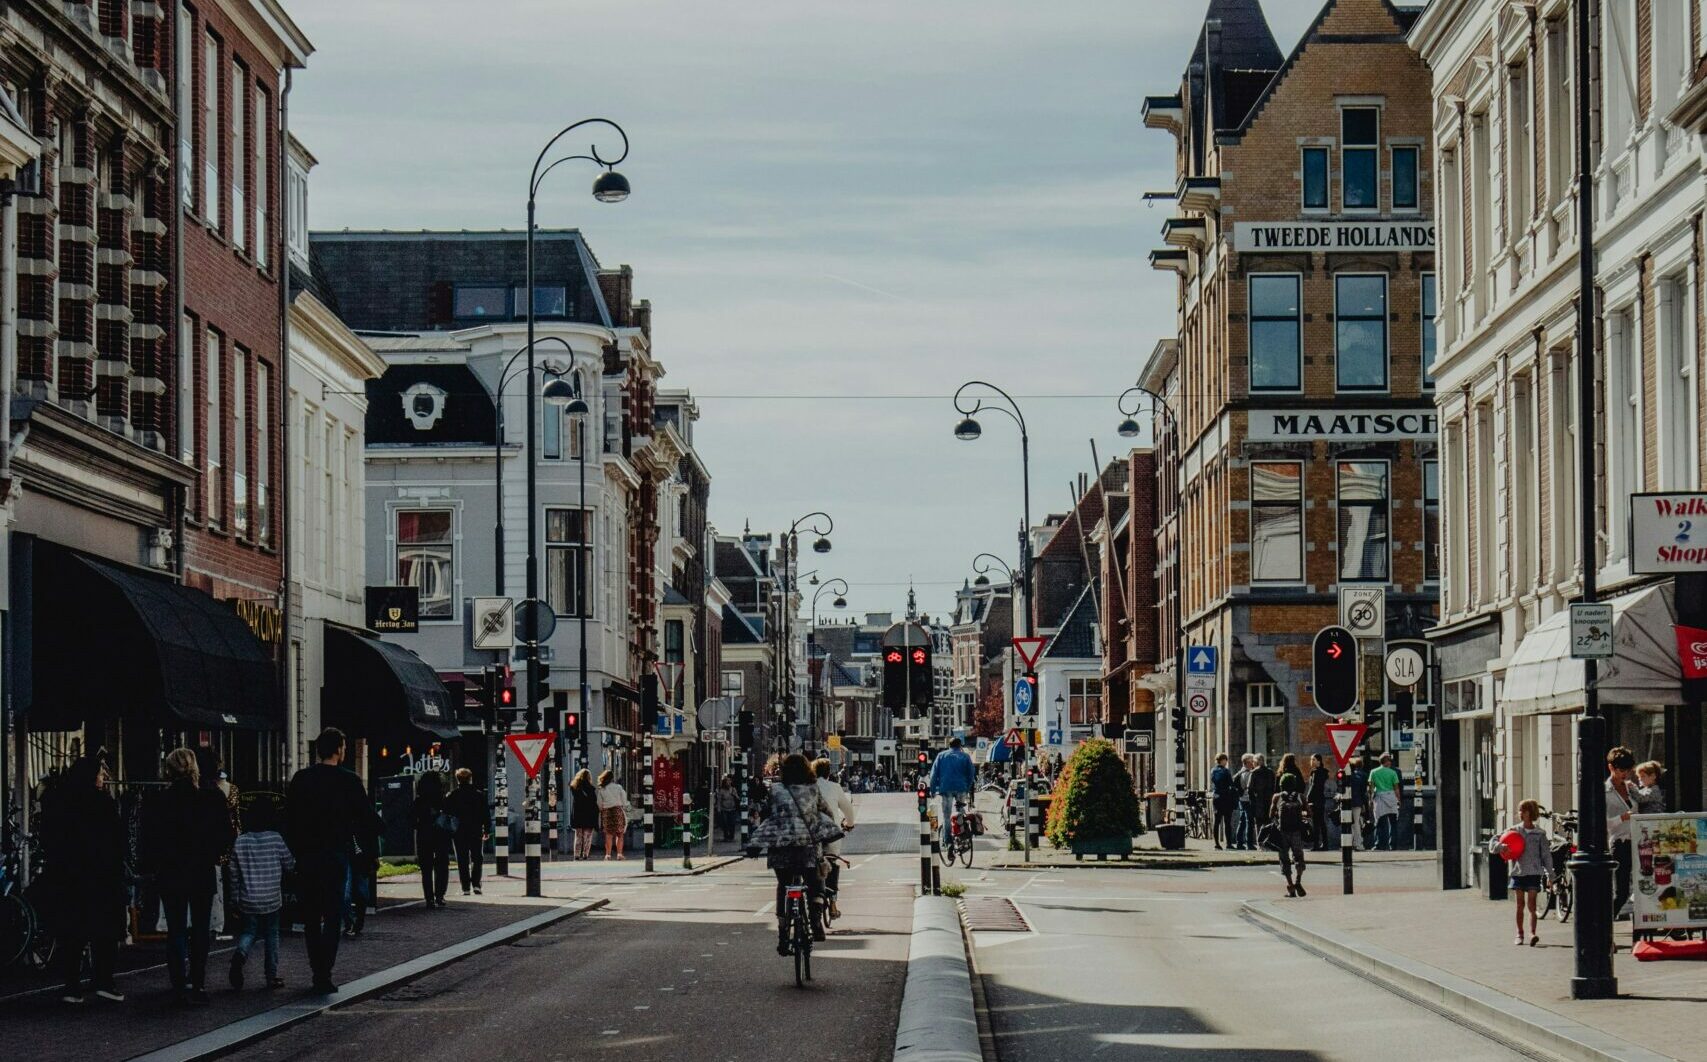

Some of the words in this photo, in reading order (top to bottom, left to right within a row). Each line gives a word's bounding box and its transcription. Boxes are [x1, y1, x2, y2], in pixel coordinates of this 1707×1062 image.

[1251, 227, 1331, 247] TWEEDE
[1337, 226, 1436, 247] HOLLANDS
[1272, 414, 1438, 435] MAATSCH
[1655, 497, 1707, 516] Walk
[1675, 520, 1692, 541] 2
[1657, 544, 1707, 564] Shop
[1355, 609, 1372, 621] 30
[1394, 657, 1415, 678] SLA
[1193, 699, 1205, 708] 30
